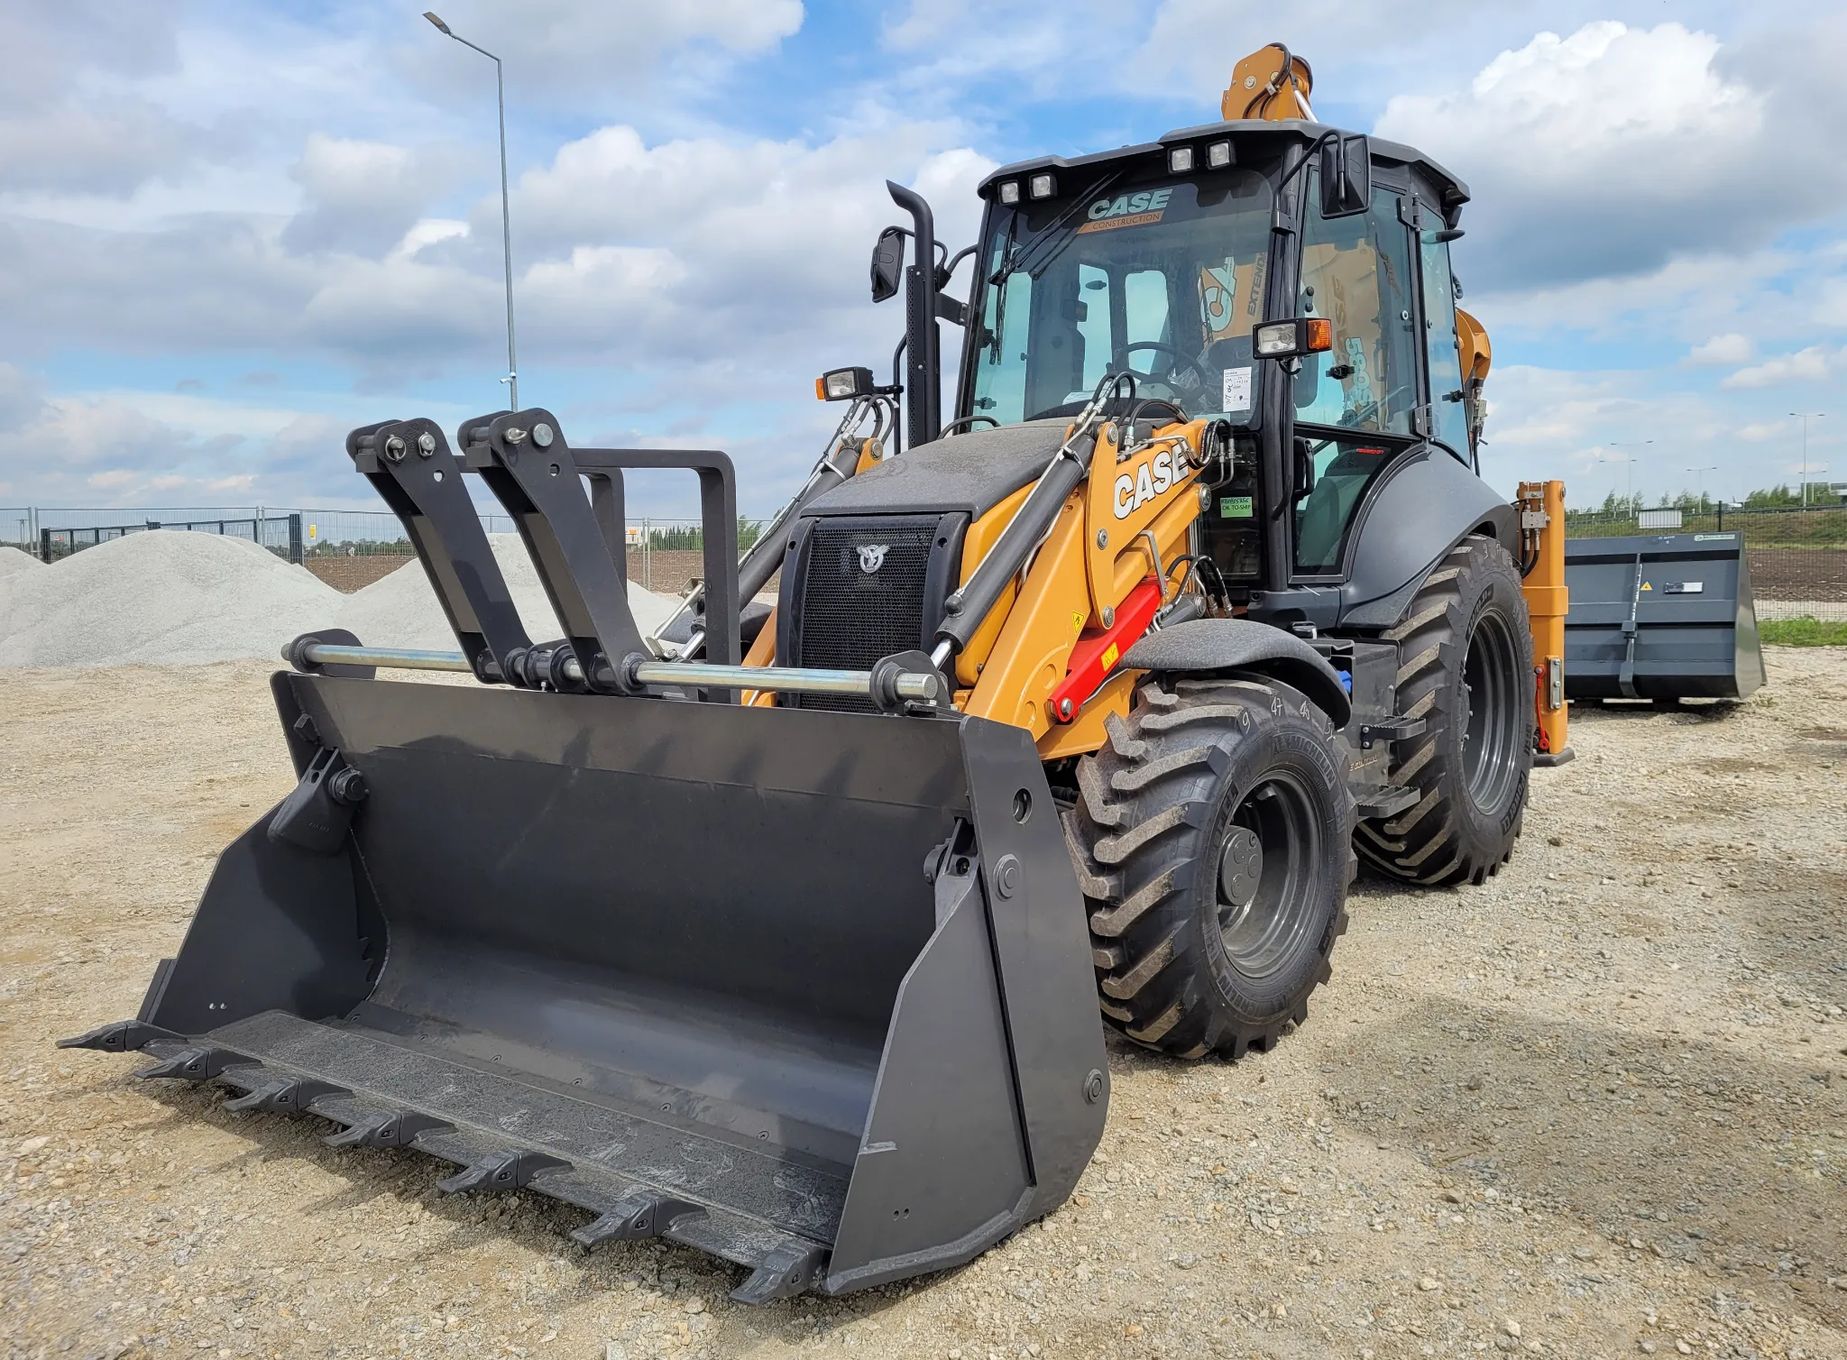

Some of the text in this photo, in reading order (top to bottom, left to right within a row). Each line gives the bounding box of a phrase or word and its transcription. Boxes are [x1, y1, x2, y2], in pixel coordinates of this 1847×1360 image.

[1087, 188, 1174, 220] CASE
[1092, 212, 1161, 231] CONSTRUCTION
[1113, 439, 1190, 521] CASE
[1288, 734, 1336, 785] MICHELIN
